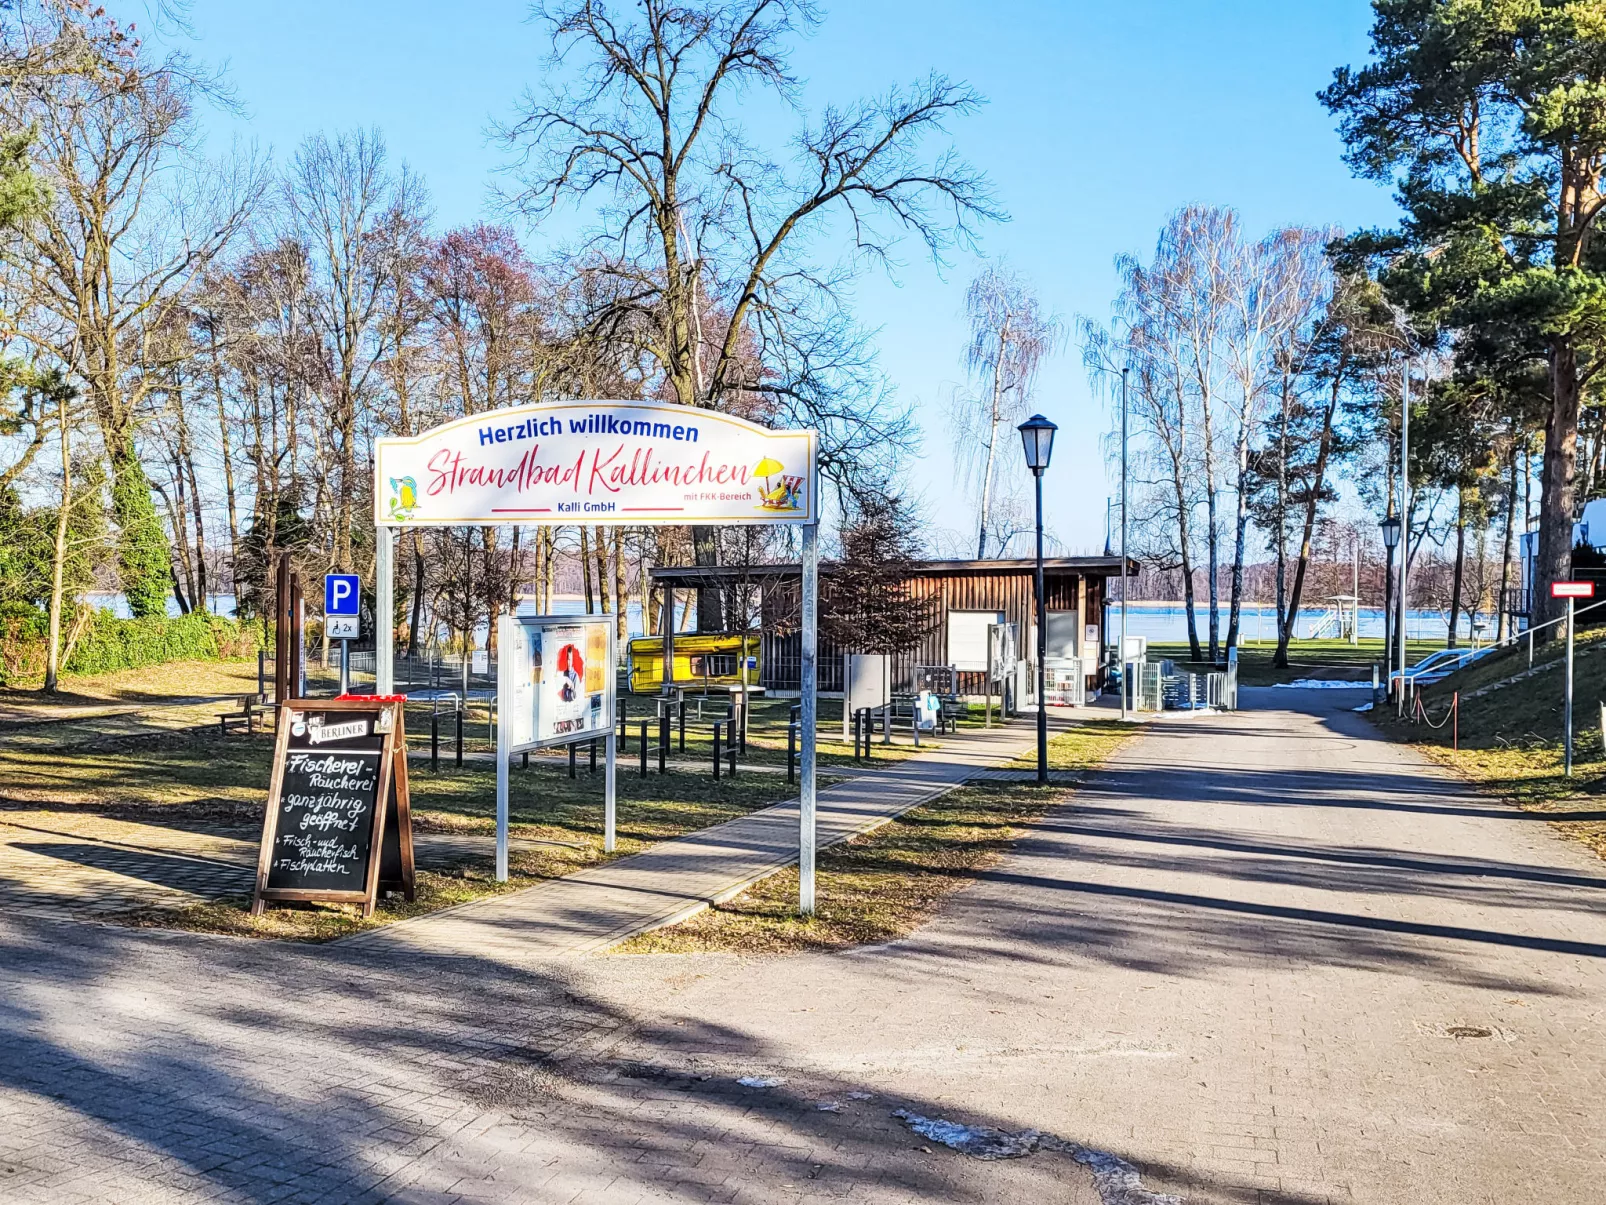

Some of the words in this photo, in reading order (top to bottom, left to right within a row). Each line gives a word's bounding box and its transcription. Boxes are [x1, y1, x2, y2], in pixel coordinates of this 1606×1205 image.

[479, 416, 562, 446] Herzlich
[569, 414, 699, 443] willkommen
[427, 444, 585, 496] Strandbad
[588, 443, 751, 495] Kallinchen
[684, 493, 698, 501] mit
[700, 492, 752, 501] FKK-Bereich
[557, 502, 581, 512] Kalli
[583, 502, 615, 512] GmbH
[332, 580, 351, 610] P
[343, 623, 352, 632] 2x
[321, 724, 364, 739] BERLINER
[309, 773, 377, 791] Räucherei
[284, 792, 366, 818] ganzjährig
[299, 811, 359, 832] geöffnet
